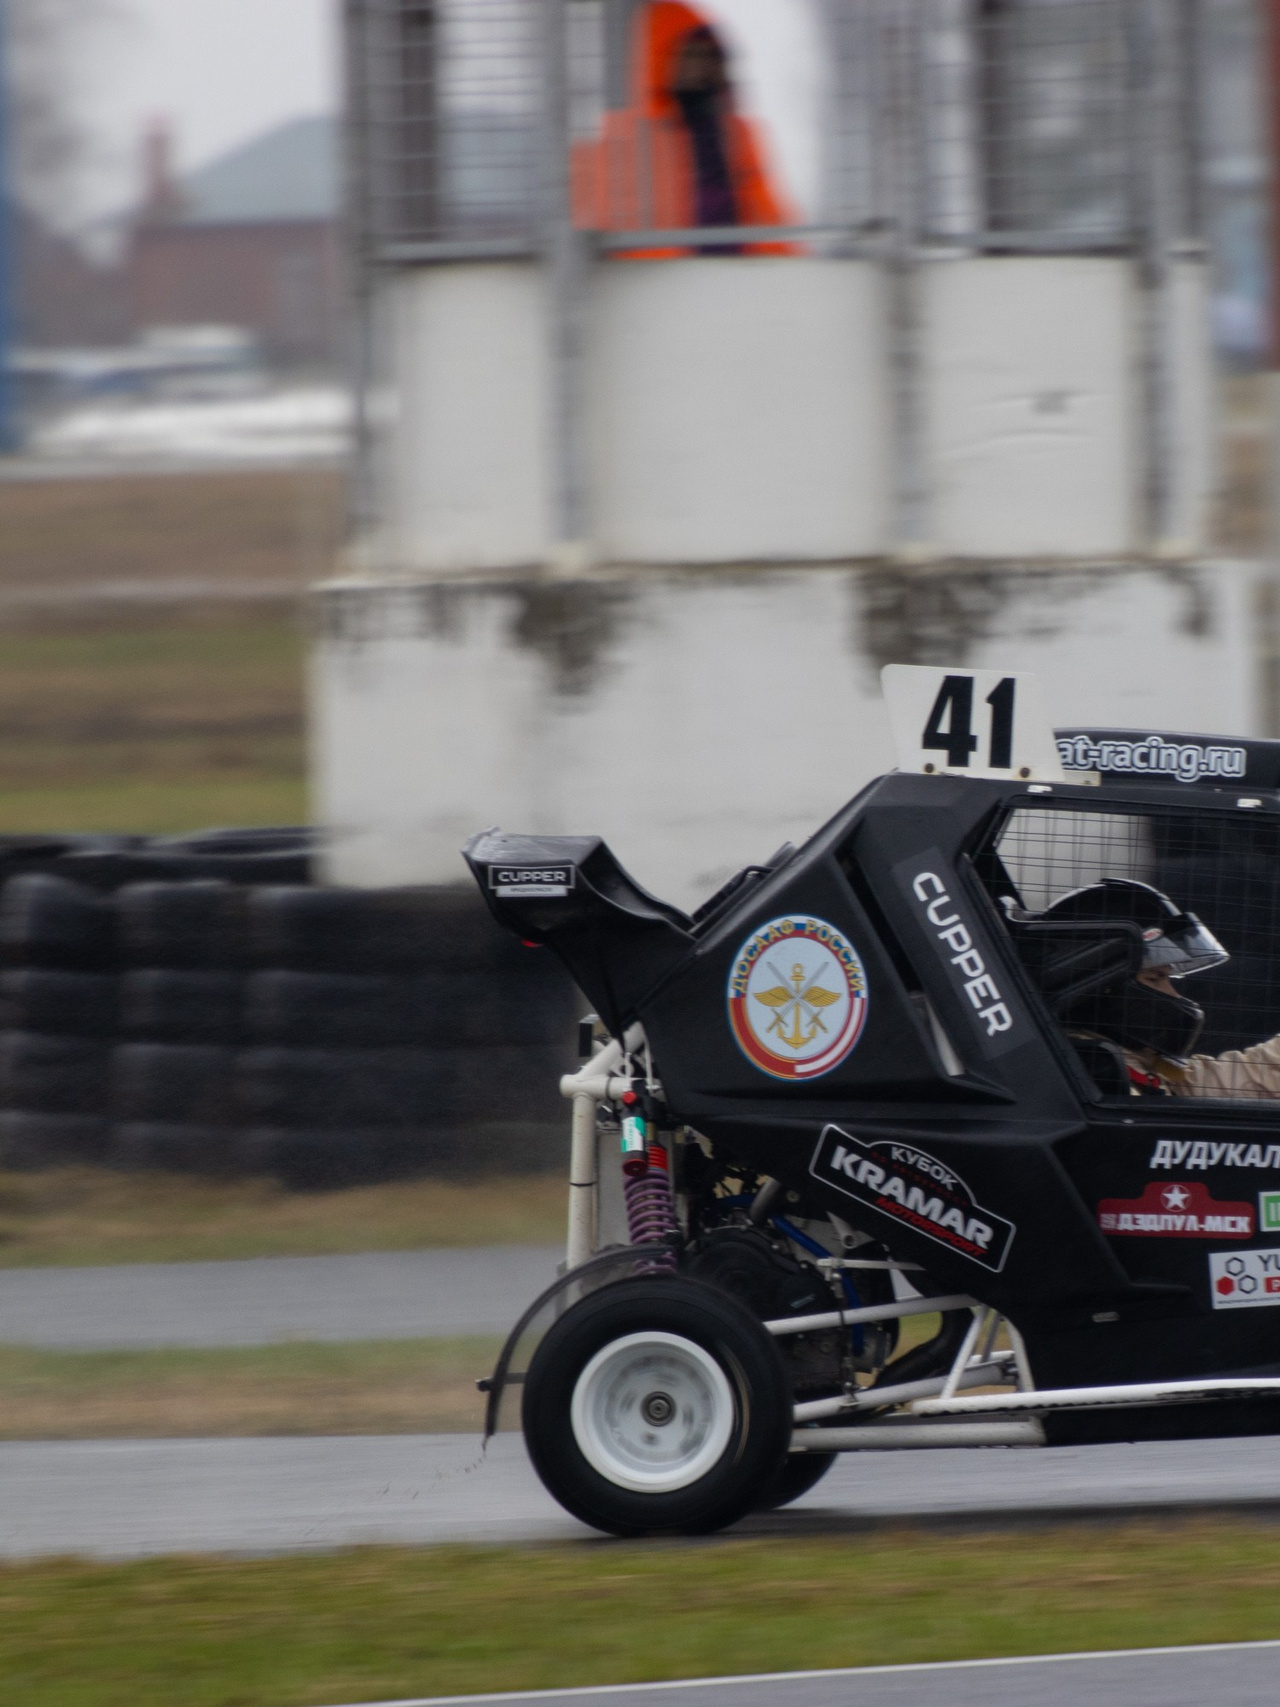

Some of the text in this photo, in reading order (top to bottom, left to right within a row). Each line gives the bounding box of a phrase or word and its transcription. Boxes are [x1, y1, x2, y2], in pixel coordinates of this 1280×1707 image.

[922, 675, 1016, 769] 41
[498, 871, 566, 882] CUPPER
[731, 920, 864, 993] ДОСААФ РОССИИ
[913, 872, 1013, 1036] CUPPER
[830, 1145, 994, 1250] KRAMAR
[891, 1146, 959, 1191] КУБОК
[875, 1196, 989, 1257] MOTORSPORT
